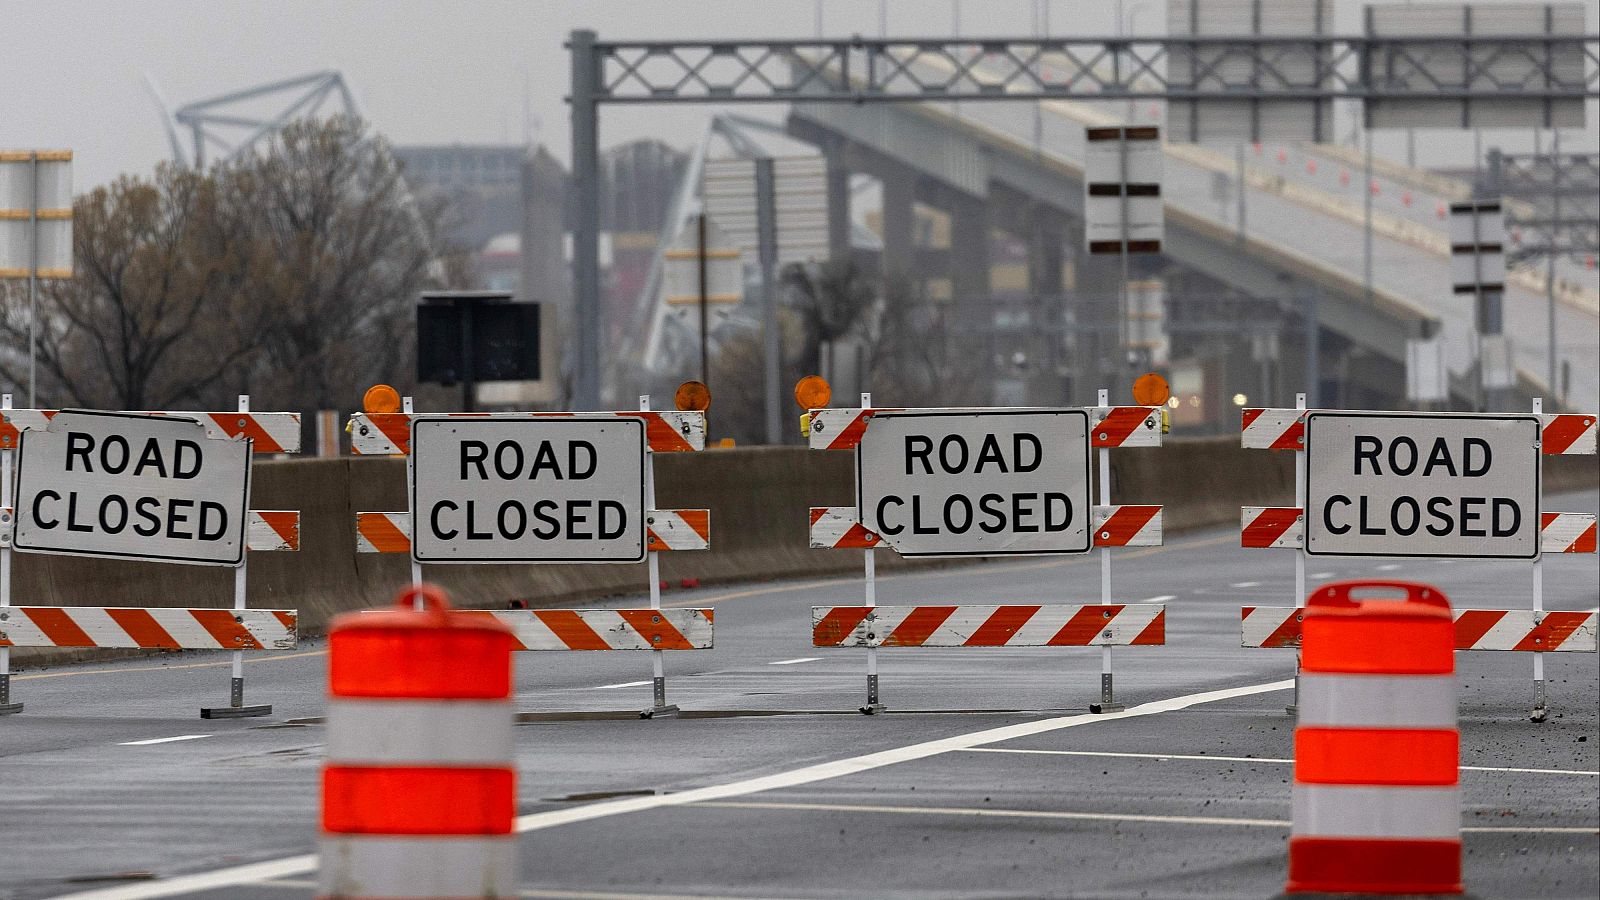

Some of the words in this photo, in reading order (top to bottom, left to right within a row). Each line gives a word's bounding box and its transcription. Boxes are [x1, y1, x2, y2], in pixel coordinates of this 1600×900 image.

[66, 432, 202, 479] ROAD
[461, 440, 597, 480] ROAD
[905, 433, 1042, 475] ROAD
[1354, 436, 1492, 477] ROAD
[33, 490, 228, 541] CLOSED
[431, 500, 626, 540] CLOSED
[877, 493, 1073, 535] CLOSED
[1324, 495, 1521, 537] CLOSED
